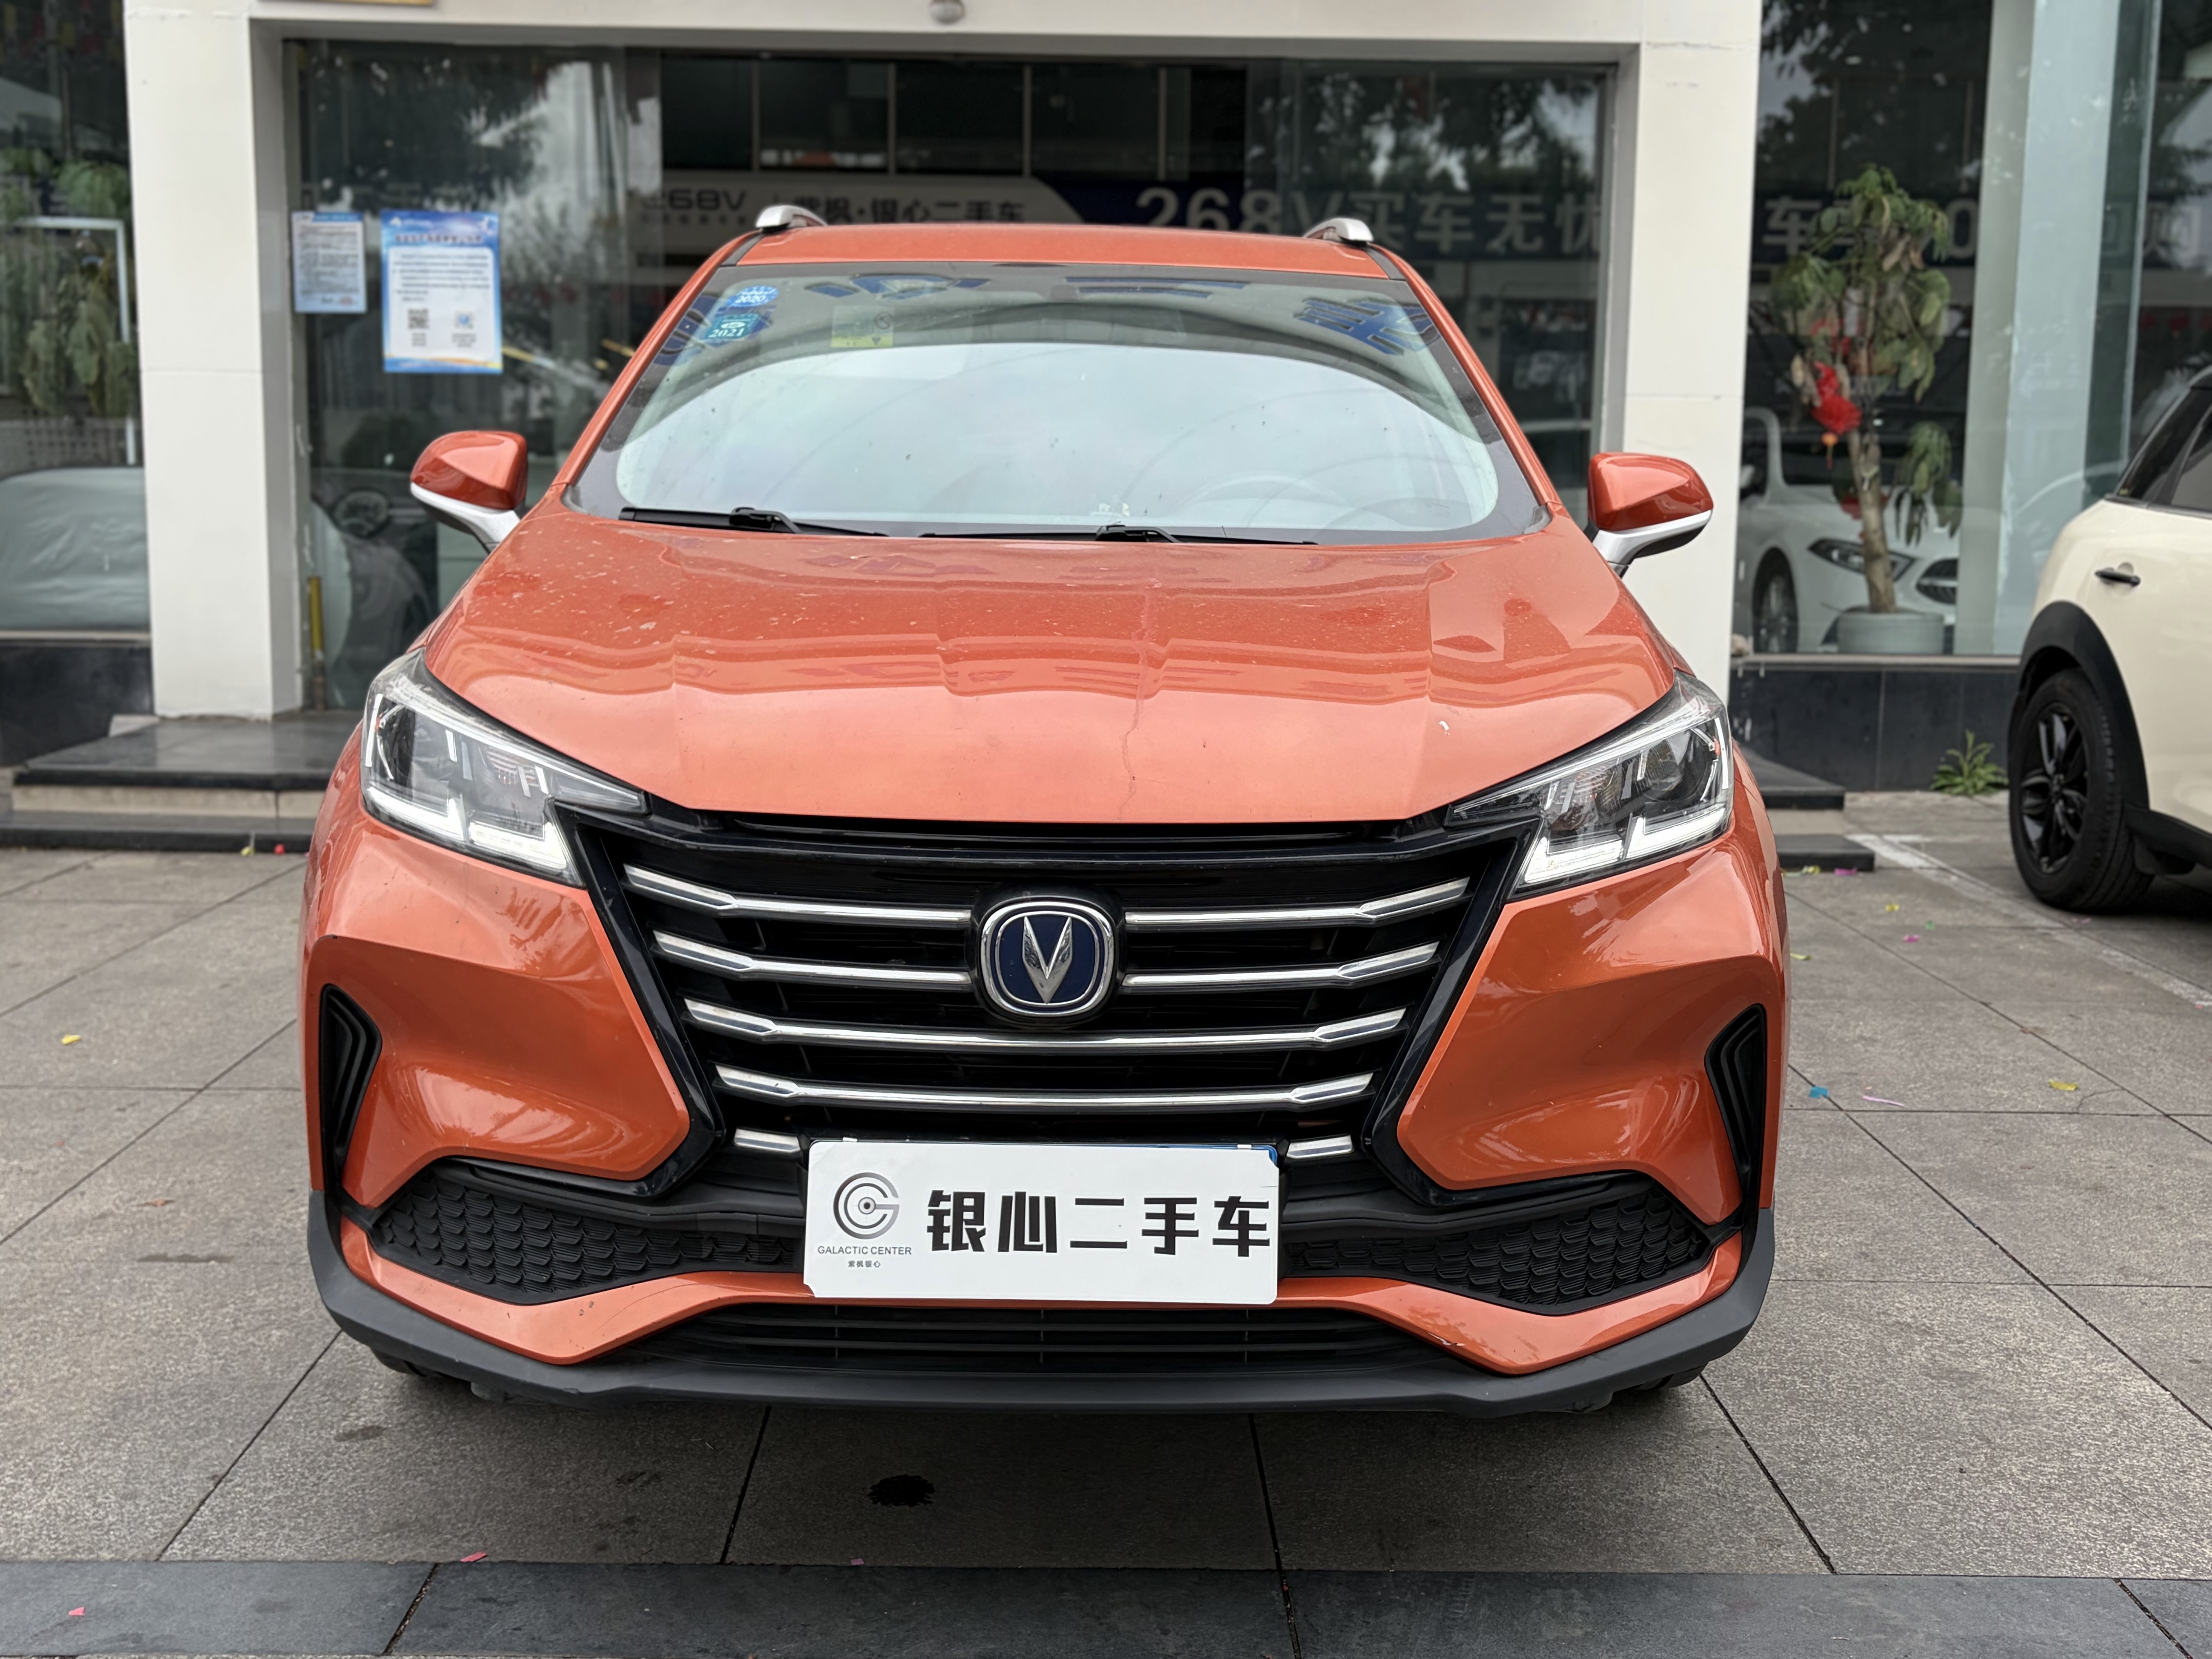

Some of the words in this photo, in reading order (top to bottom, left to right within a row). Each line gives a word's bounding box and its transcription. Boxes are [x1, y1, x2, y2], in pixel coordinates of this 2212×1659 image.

[735, 295, 766, 304] 2020
[708, 328, 745, 338] 2021
[926, 1190, 1271, 1257] 银心二手车
[817, 1246, 868, 1254] GALACTIC
[871, 1246, 912, 1255] CENTER
